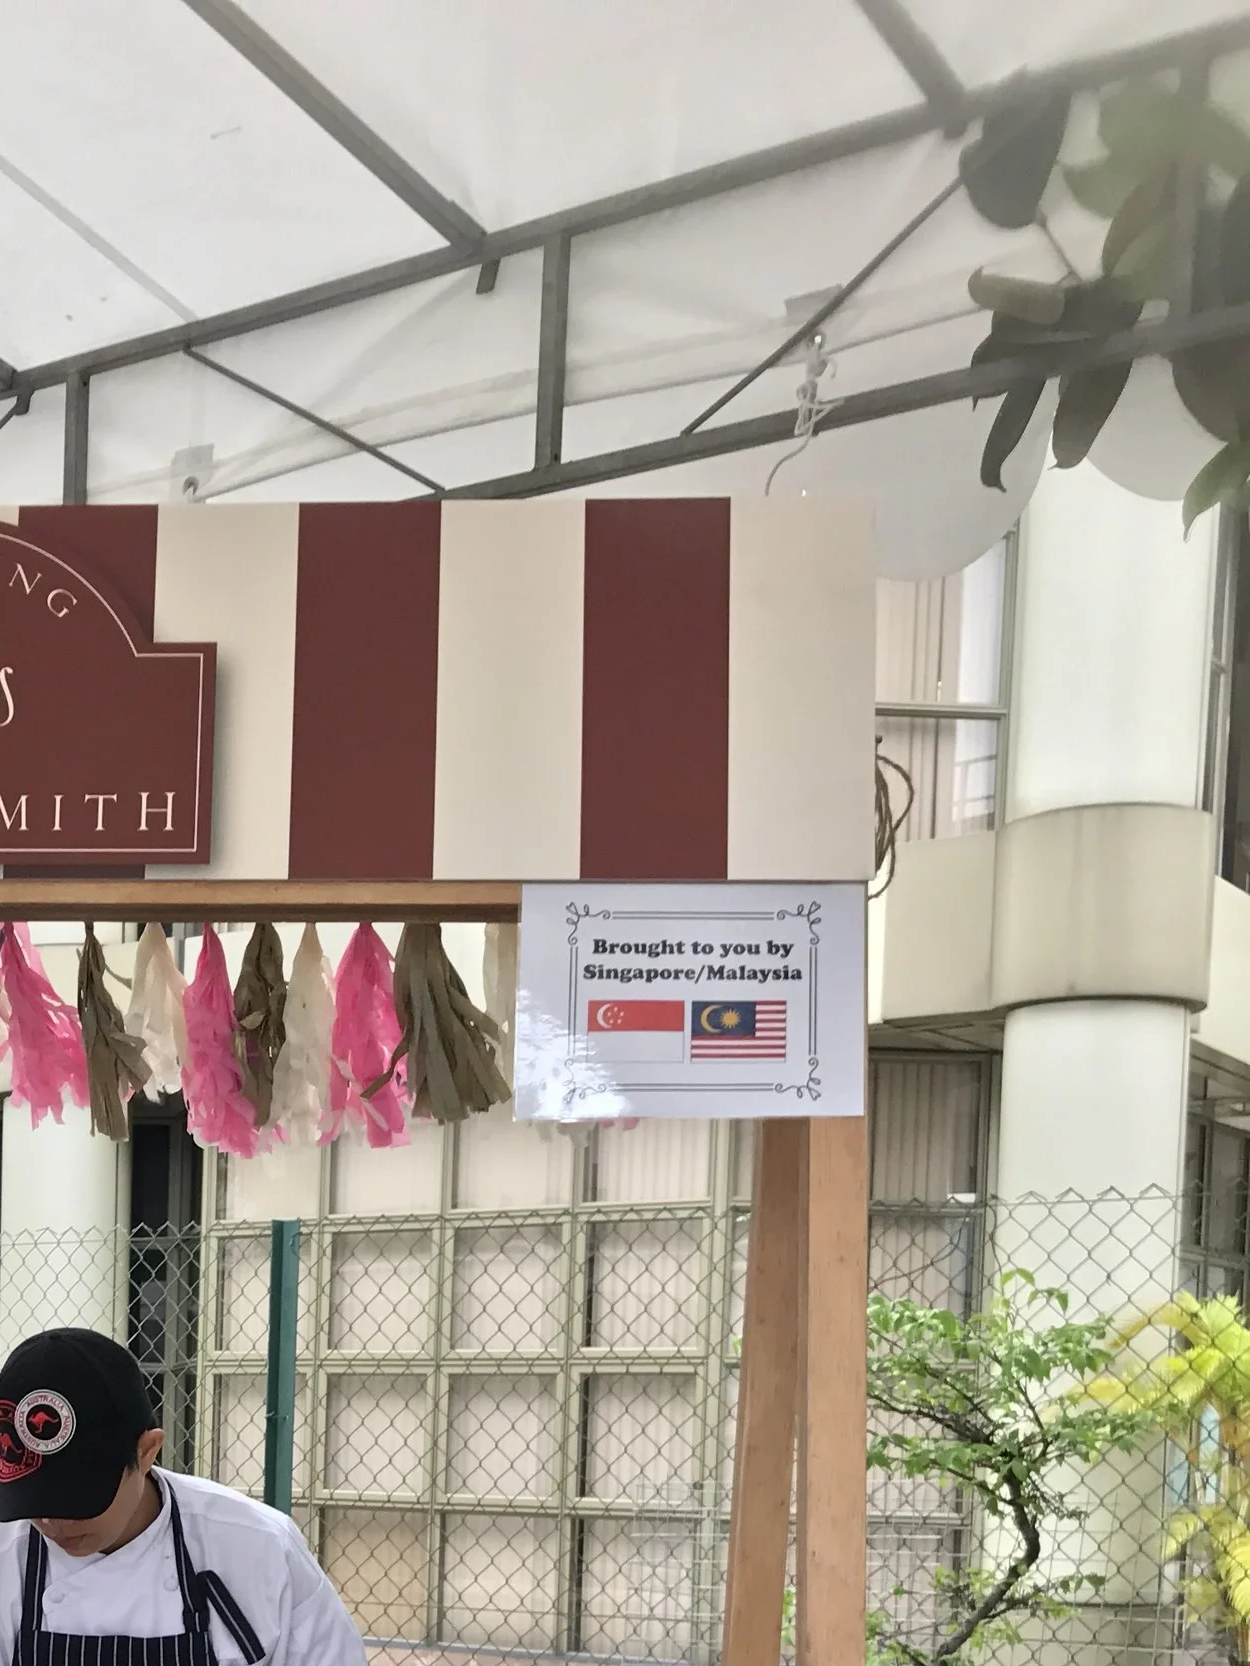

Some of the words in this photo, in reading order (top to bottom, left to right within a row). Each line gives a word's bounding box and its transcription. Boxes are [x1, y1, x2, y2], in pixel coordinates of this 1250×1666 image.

[592, 938, 688, 958] Brought
[690, 939, 715, 956] to
[719, 942, 761, 959] you
[766, 938, 795, 959] by
[582, 964, 803, 984] Singapore/Malaysia
